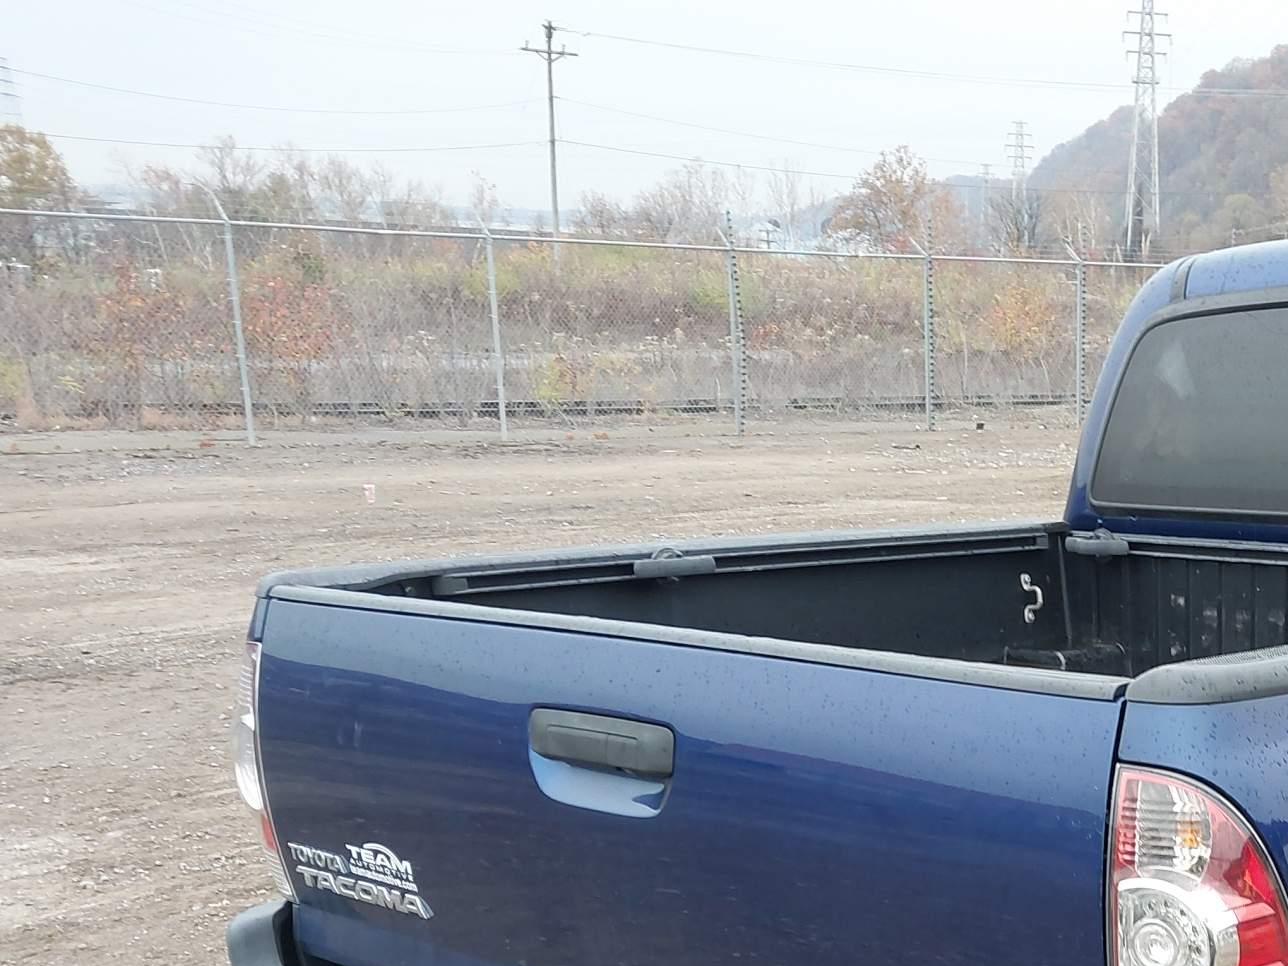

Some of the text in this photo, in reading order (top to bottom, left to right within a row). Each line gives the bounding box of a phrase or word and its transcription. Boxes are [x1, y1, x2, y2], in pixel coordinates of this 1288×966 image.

[288, 842, 349, 874] TOYOTA
[345, 843, 413, 876] TEAM
[350, 858, 414, 882] AUTOMOTIVE
[296, 865, 434, 919] TACOMA
